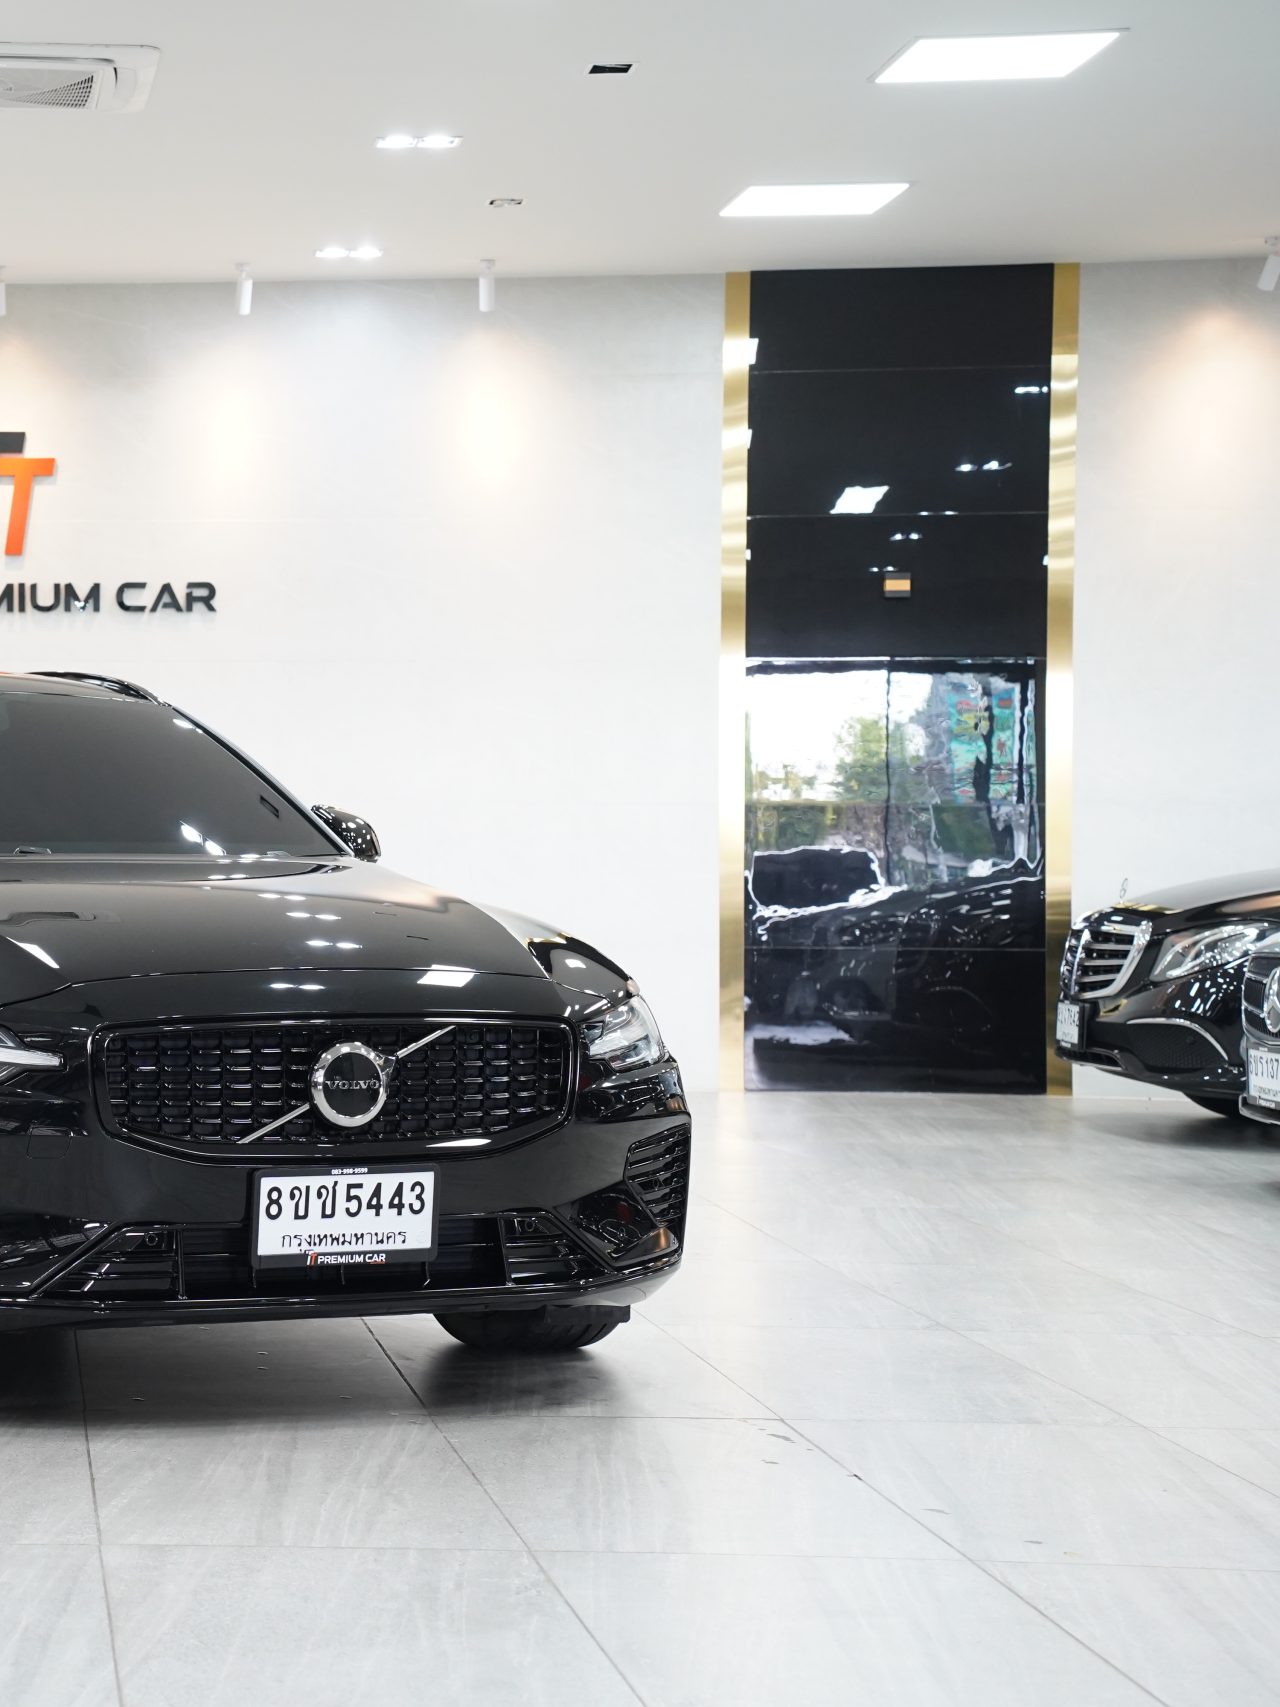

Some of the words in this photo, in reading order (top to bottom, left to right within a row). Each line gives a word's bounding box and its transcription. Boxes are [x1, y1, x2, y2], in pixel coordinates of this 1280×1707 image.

[115, 582, 217, 613] CAR
[325, 1080, 380, 1090] VOLVO
[281, 1231, 407, 1252] กรุงเทพมหานคร
[317, 1254, 364, 1264] PREMIUM
[365, 1253, 386, 1263] CAR
